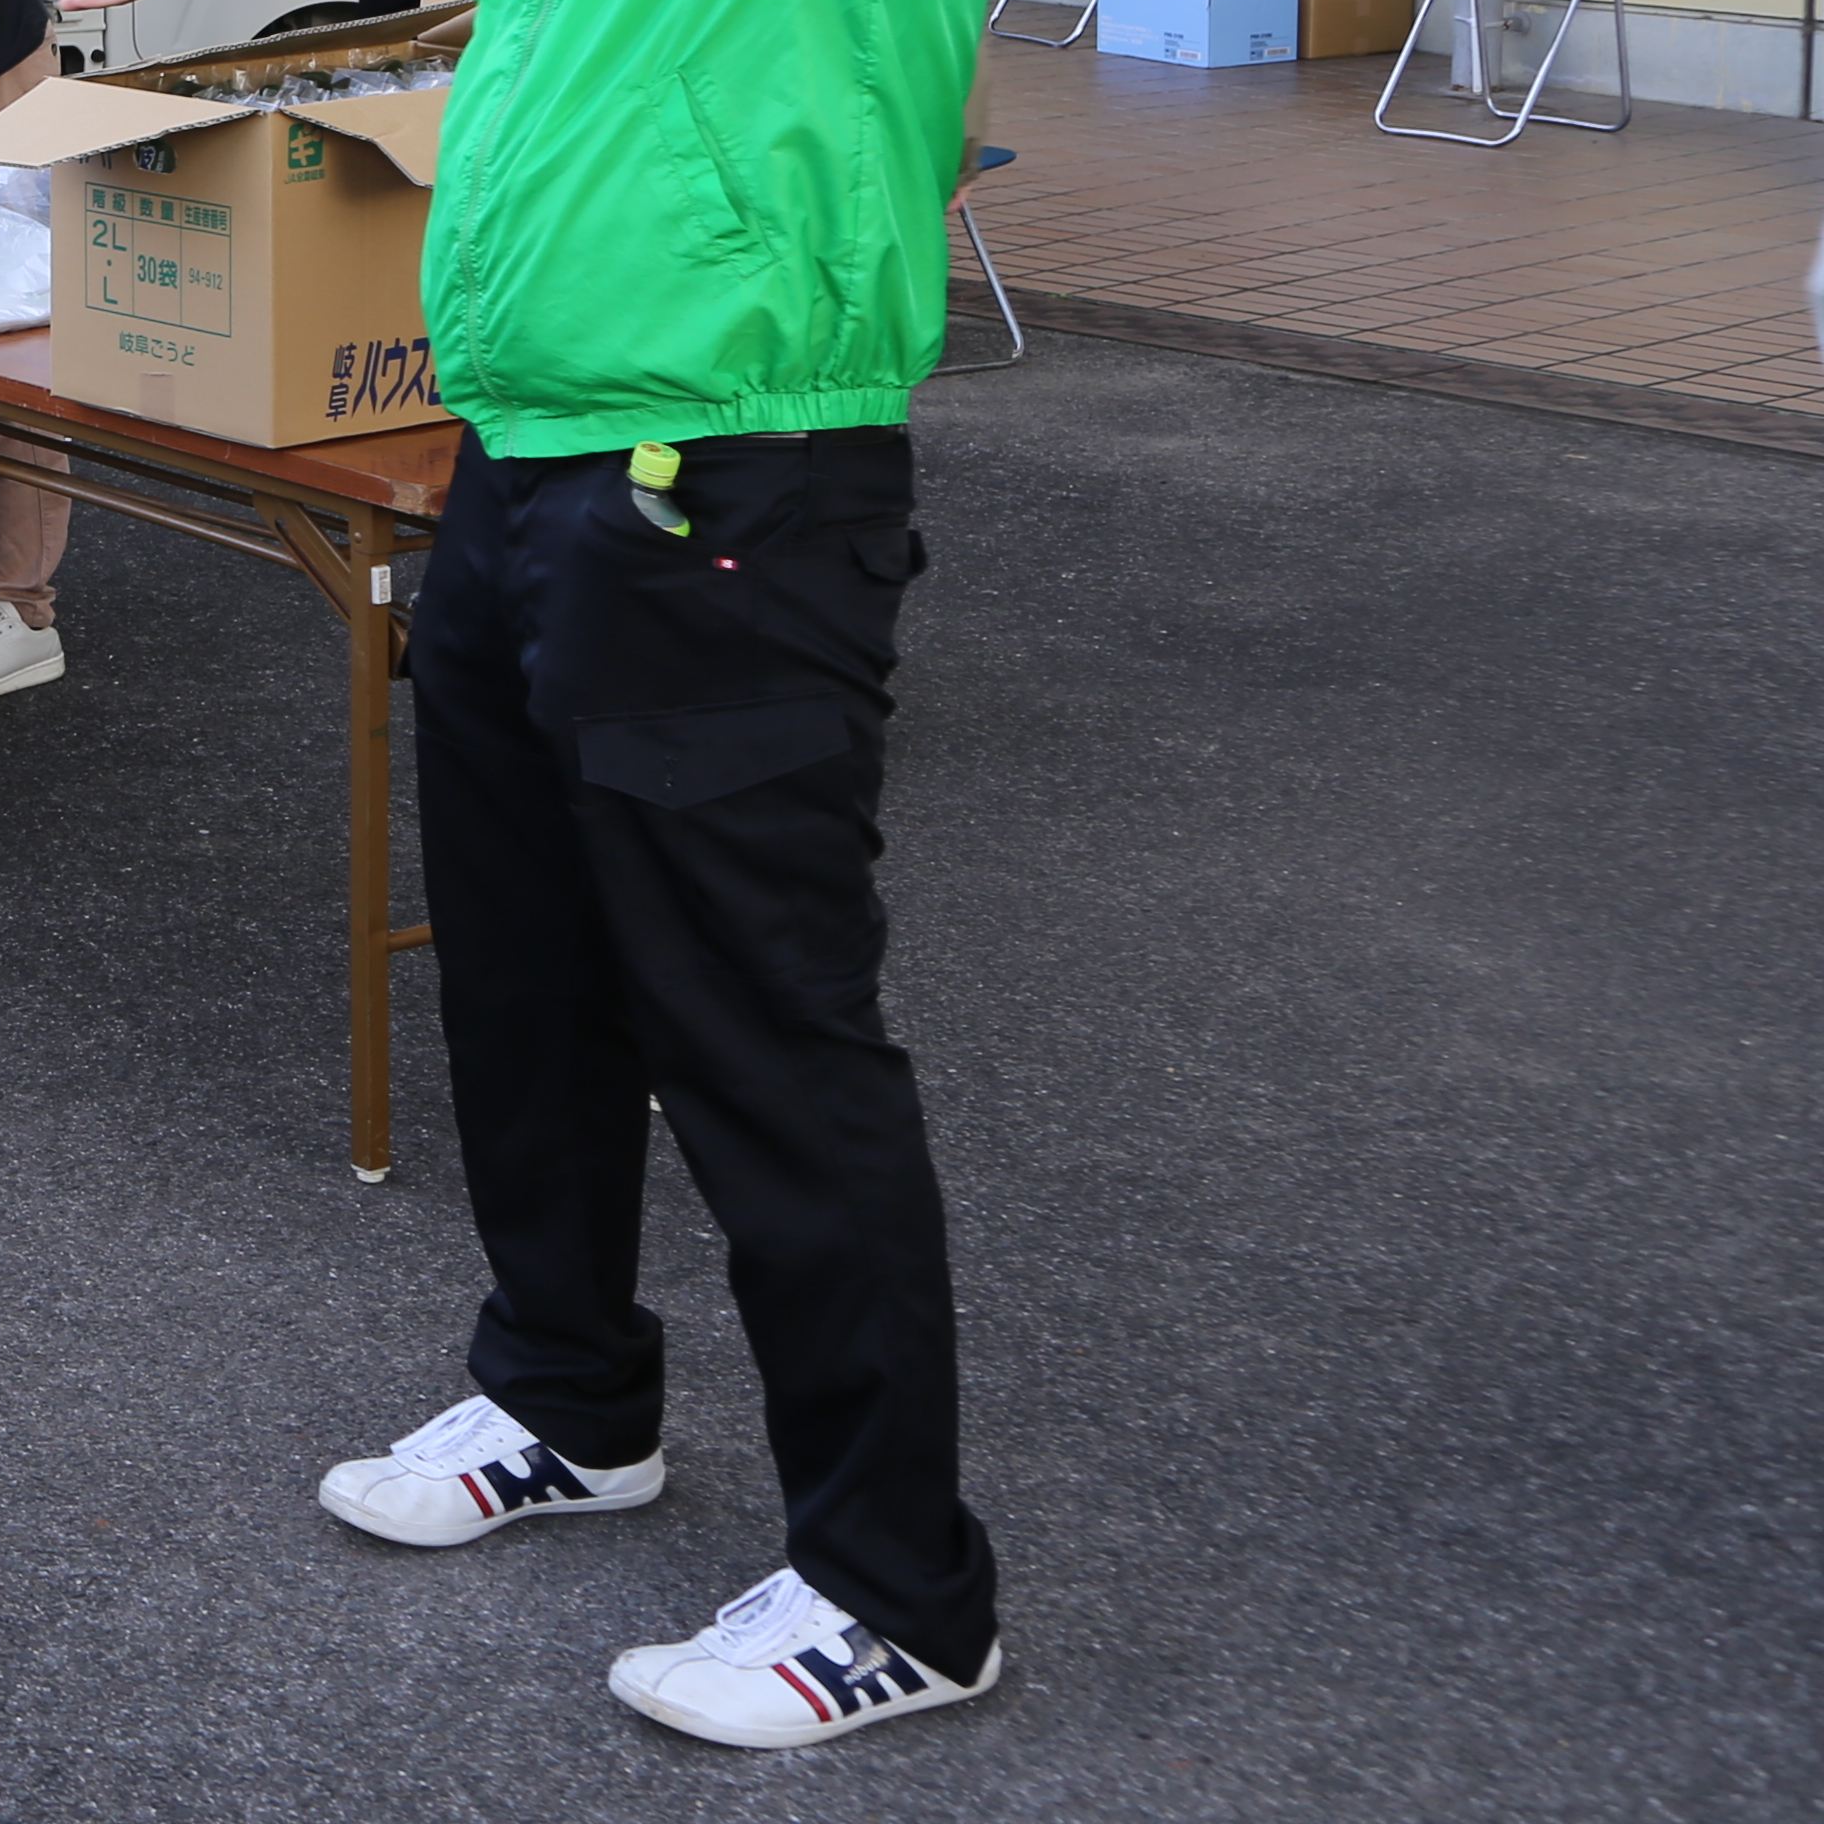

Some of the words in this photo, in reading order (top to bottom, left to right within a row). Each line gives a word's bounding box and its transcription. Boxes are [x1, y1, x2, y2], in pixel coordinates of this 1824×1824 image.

[139, 197, 176, 222] 数量
[92, 219, 128, 252] 2L
[136, 254, 178, 289] 30袋
[188, 267, 223, 290] 94-912
[118, 331, 196, 367] 岐阜ごうど
[325, 341, 358, 423] 岐阜
